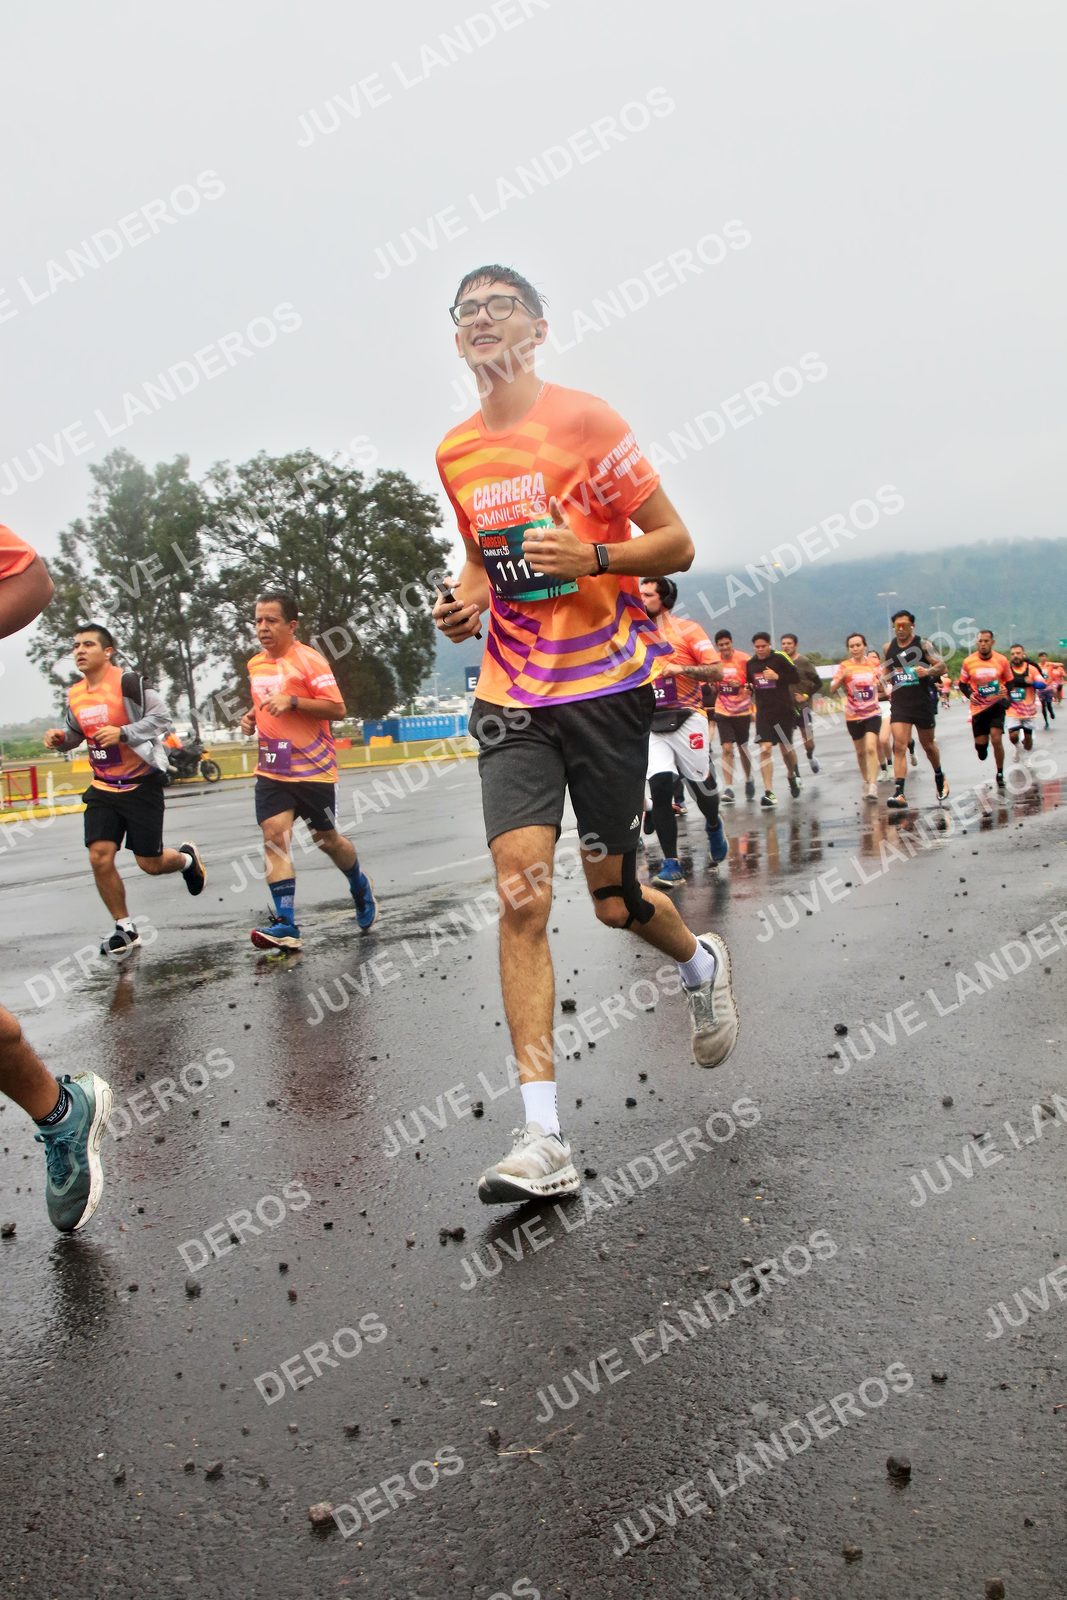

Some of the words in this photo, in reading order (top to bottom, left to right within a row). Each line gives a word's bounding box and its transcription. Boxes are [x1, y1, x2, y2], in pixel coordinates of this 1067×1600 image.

[473, 472, 545, 511] CARRERA
[476, 502, 528, 528] OMNILIFE
[481, 535, 507, 548] CARRERA
